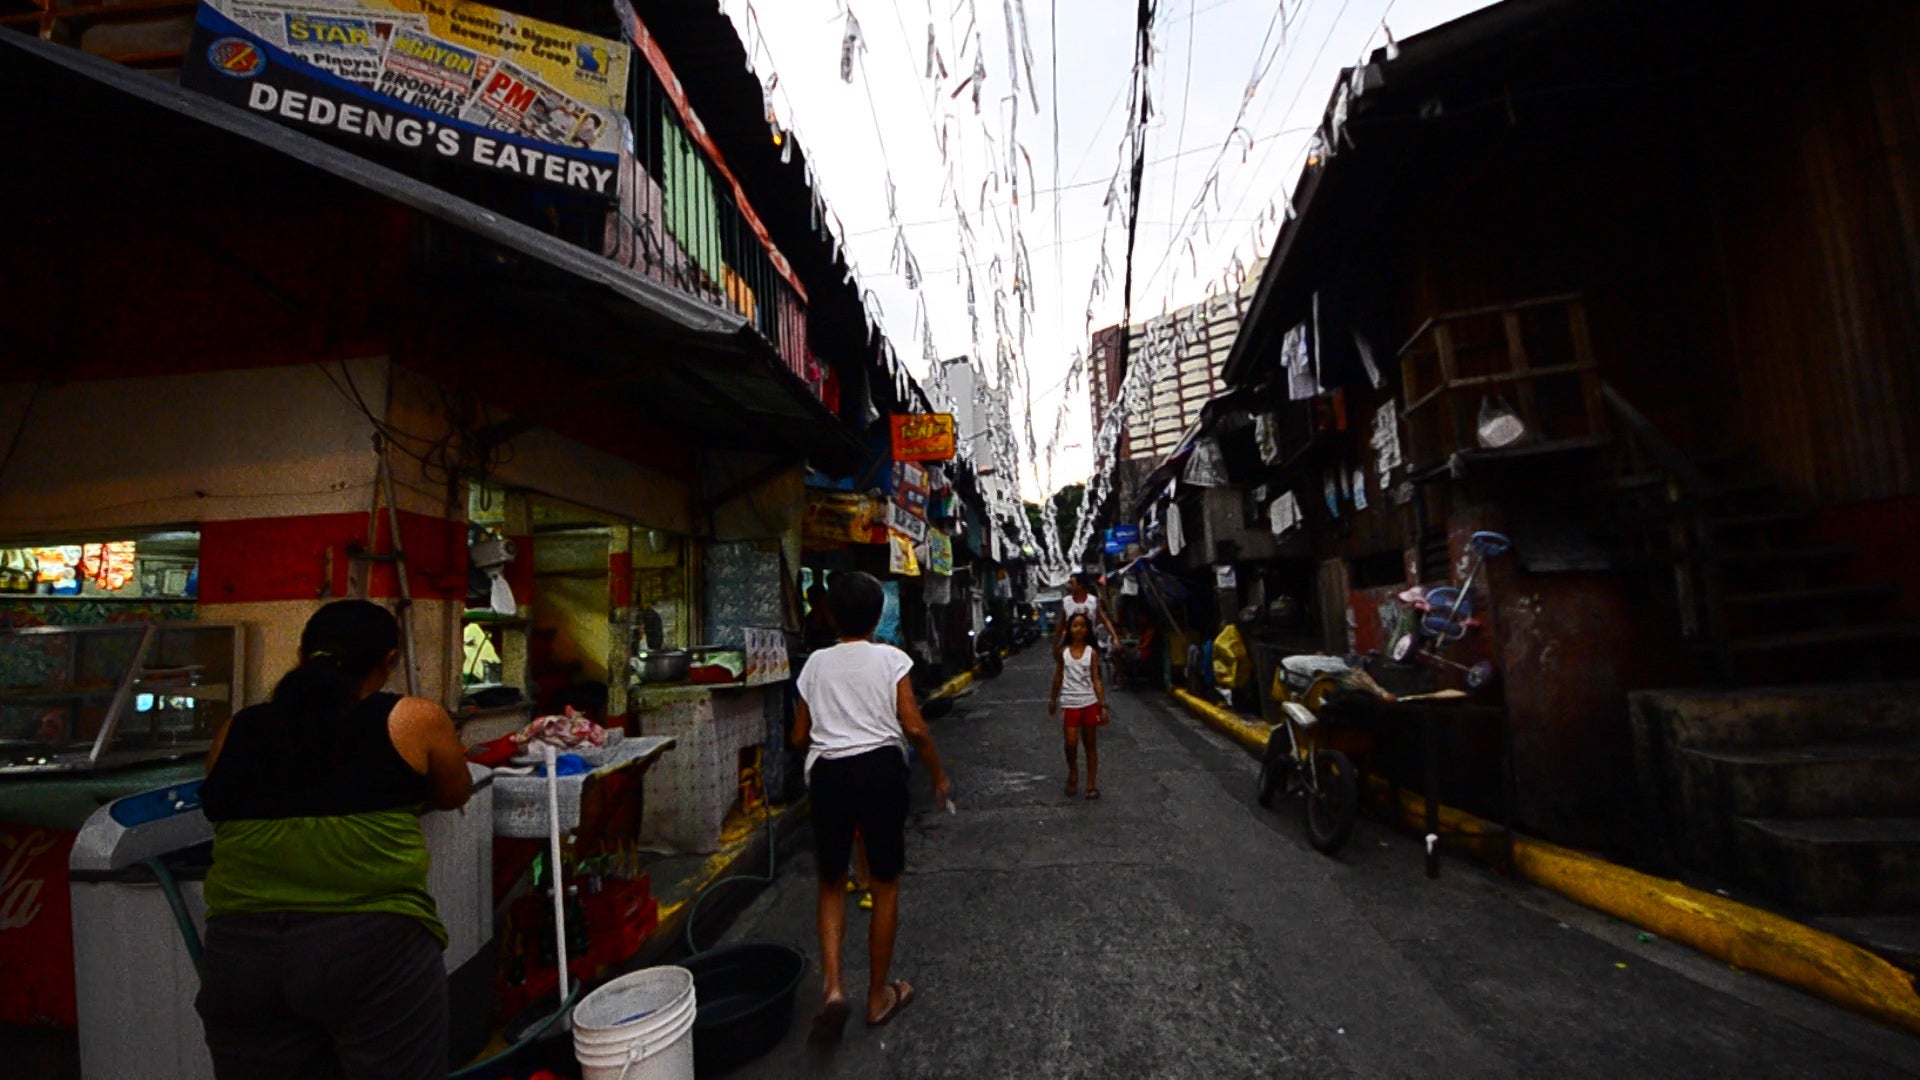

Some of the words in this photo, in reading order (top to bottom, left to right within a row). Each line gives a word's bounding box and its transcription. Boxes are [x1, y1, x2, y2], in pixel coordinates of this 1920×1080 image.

[289, 18, 371, 48] STAR
[420, 0, 446, 16] The
[450, 8, 517, 36] Country's
[521, 27, 572, 51] Biggest
[451, 21, 527, 52] Newspaper
[532, 45, 571, 66] Group
[393, 34, 473, 74] NGAYON
[381, 71, 466, 105] BRODKAS
[486, 72, 537, 112] PM
[248, 81, 460, 156] DEDENG'S
[472, 136, 613, 193] EATERY
